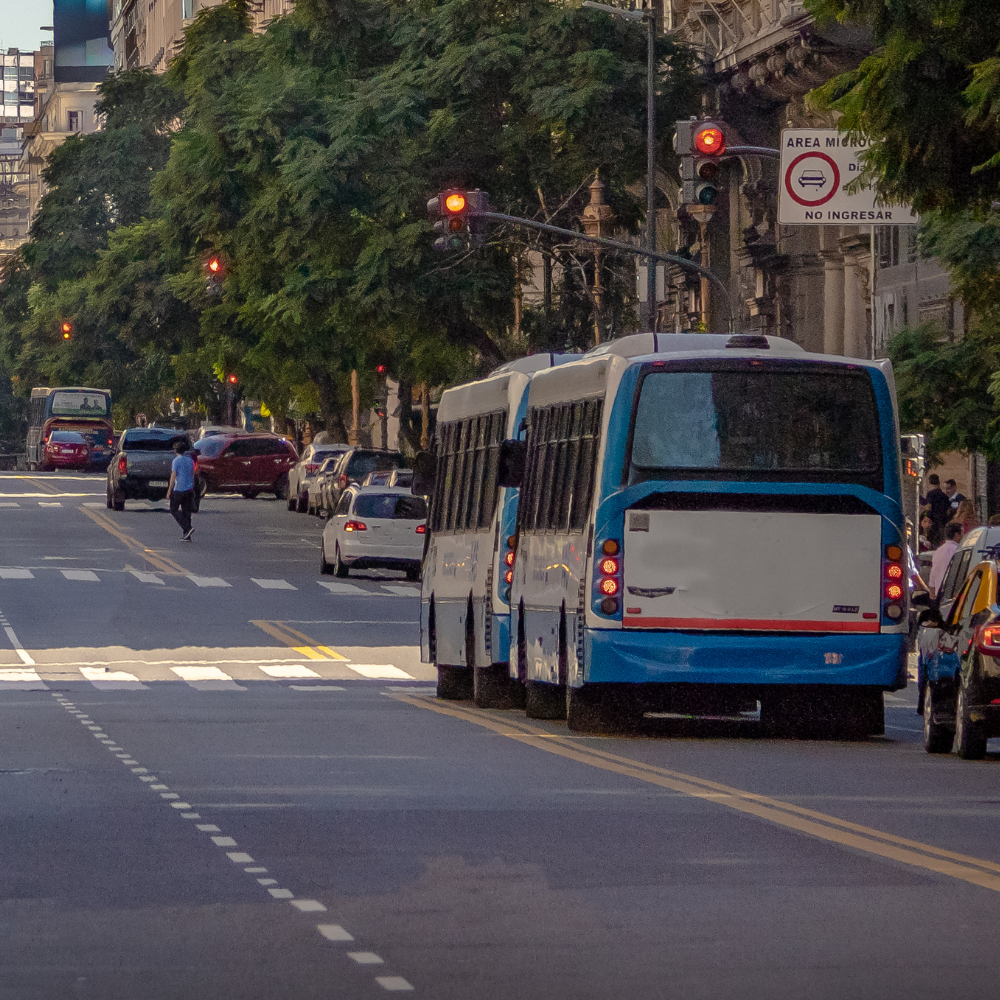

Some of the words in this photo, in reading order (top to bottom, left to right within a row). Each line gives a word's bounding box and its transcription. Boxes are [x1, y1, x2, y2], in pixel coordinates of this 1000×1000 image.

[786, 137, 821, 148] AREA
[805, 211, 823, 220] NO
[828, 211, 893, 220] INGRESAR
